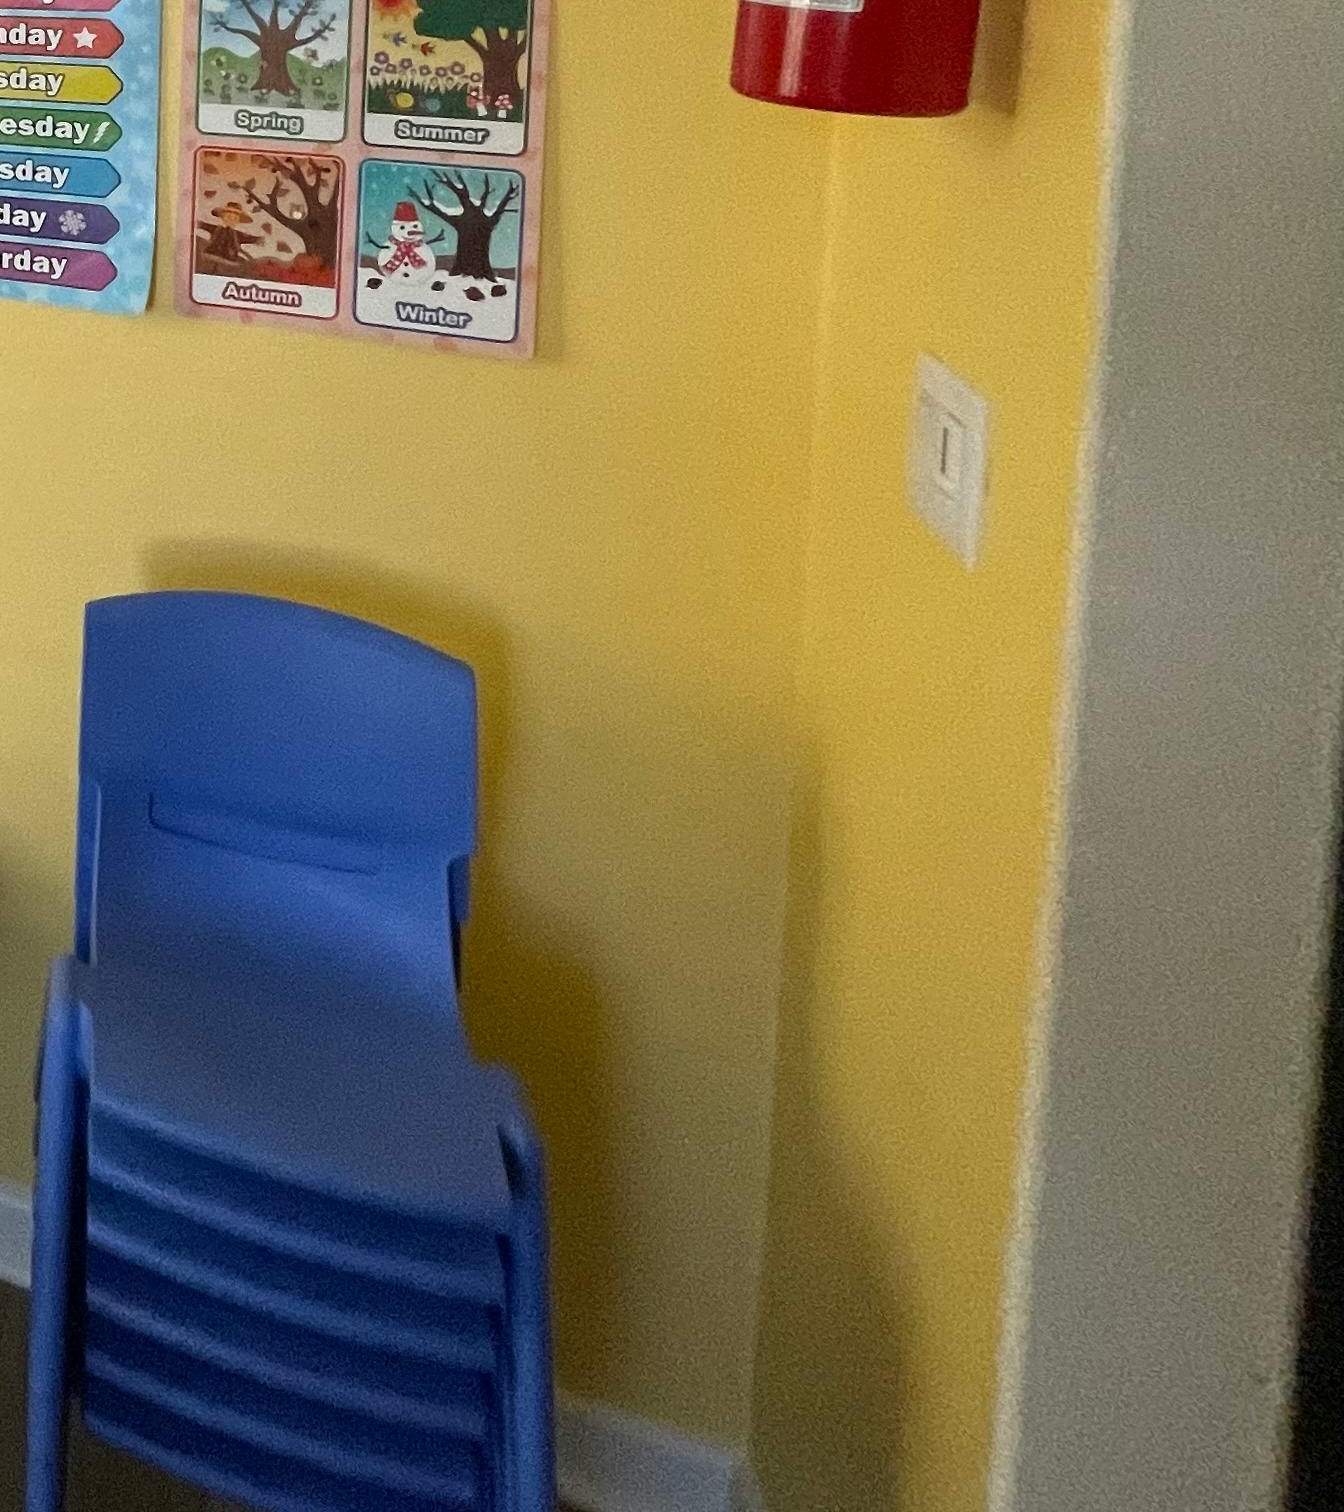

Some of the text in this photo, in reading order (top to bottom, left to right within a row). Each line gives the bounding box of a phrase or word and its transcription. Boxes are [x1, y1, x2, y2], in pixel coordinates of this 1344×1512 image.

[234, 108, 304, 135] Spring
[395, 119, 489, 144] Summer
[222, 281, 301, 307] Autumn
[396, 301, 472, 329] Winter
